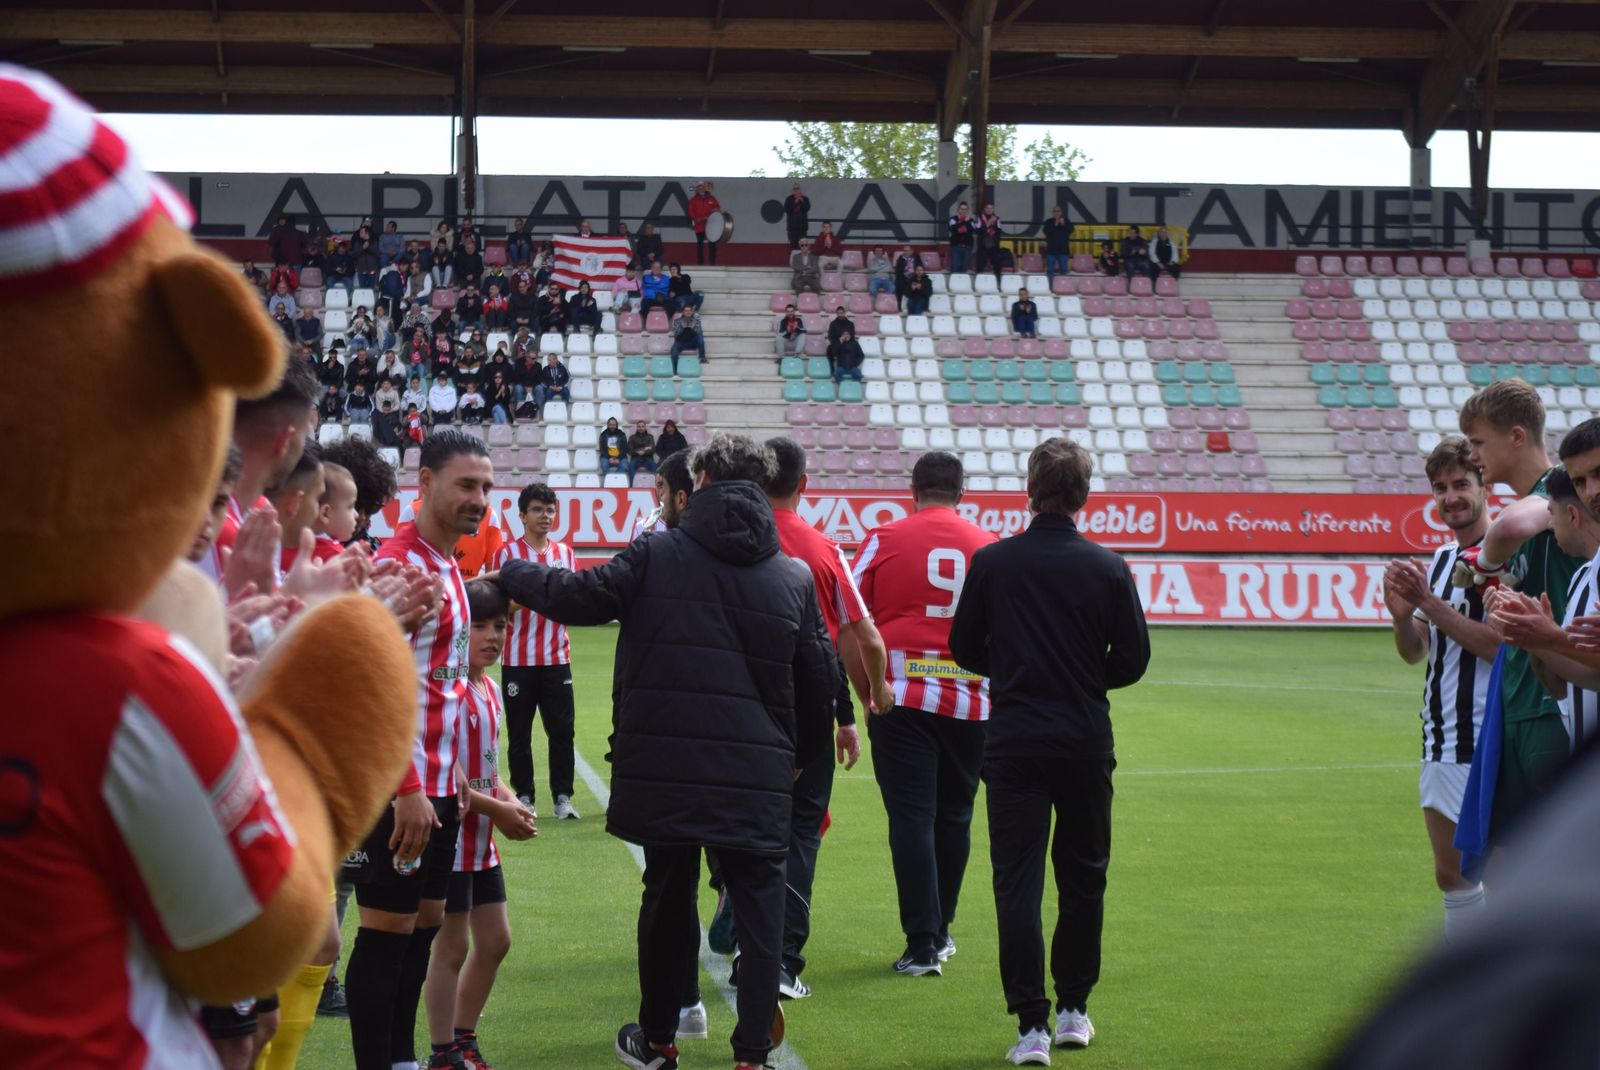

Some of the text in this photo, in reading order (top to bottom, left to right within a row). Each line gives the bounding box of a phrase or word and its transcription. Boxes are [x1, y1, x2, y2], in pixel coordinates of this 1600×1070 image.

[189, 177, 695, 237] LA PLATA
[838, 183, 1600, 250] AYUNTAMIENT
[1175, 511, 1392, 533] Una forma diferente
[926, 548, 966, 618] 9
